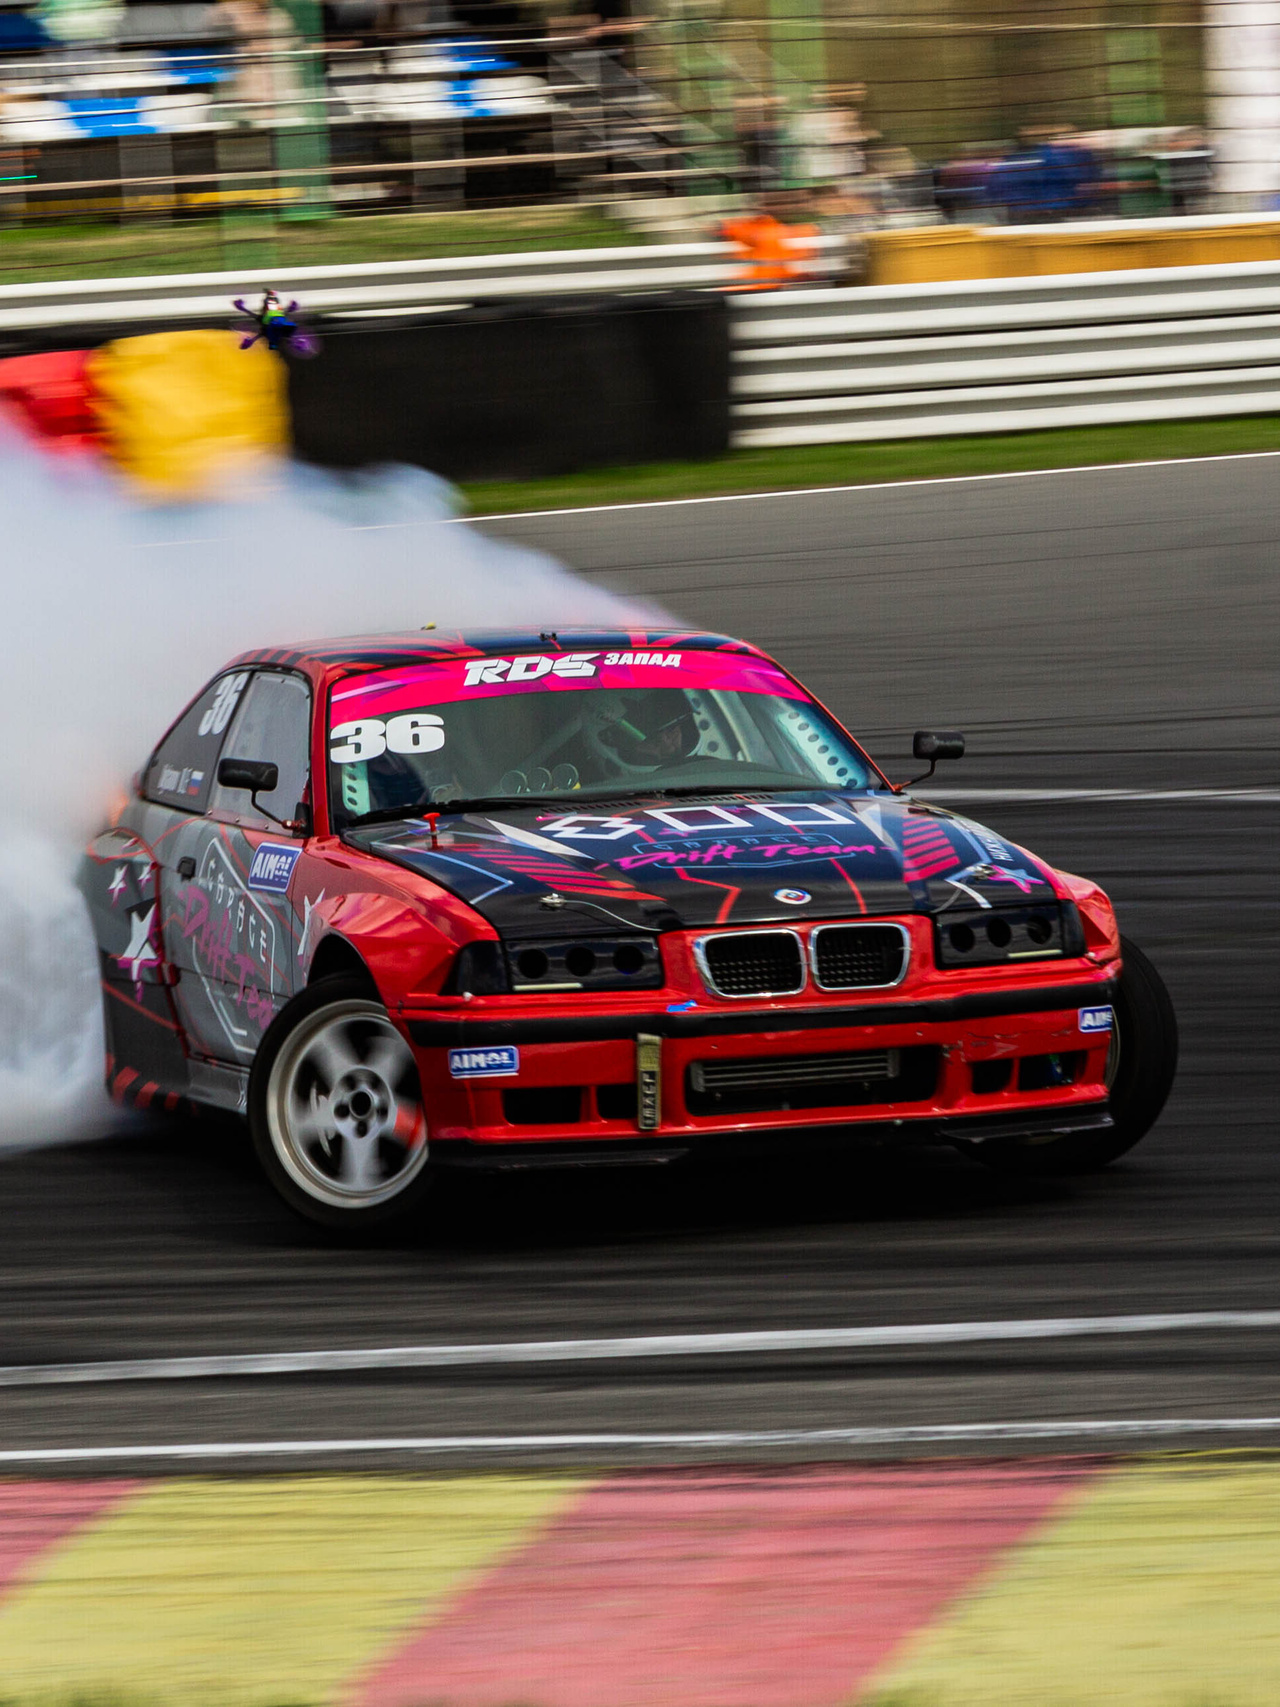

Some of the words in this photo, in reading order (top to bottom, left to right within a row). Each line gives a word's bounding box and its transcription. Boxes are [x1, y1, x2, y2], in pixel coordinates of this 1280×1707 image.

[463, 654, 601, 686] RDS
[603, 652, 682, 668] ЗАПАД
[198, 672, 249, 736] 36
[330, 713, 445, 764] 36
[618, 844, 744, 871] Drift
[750, 843, 877, 858] Team
